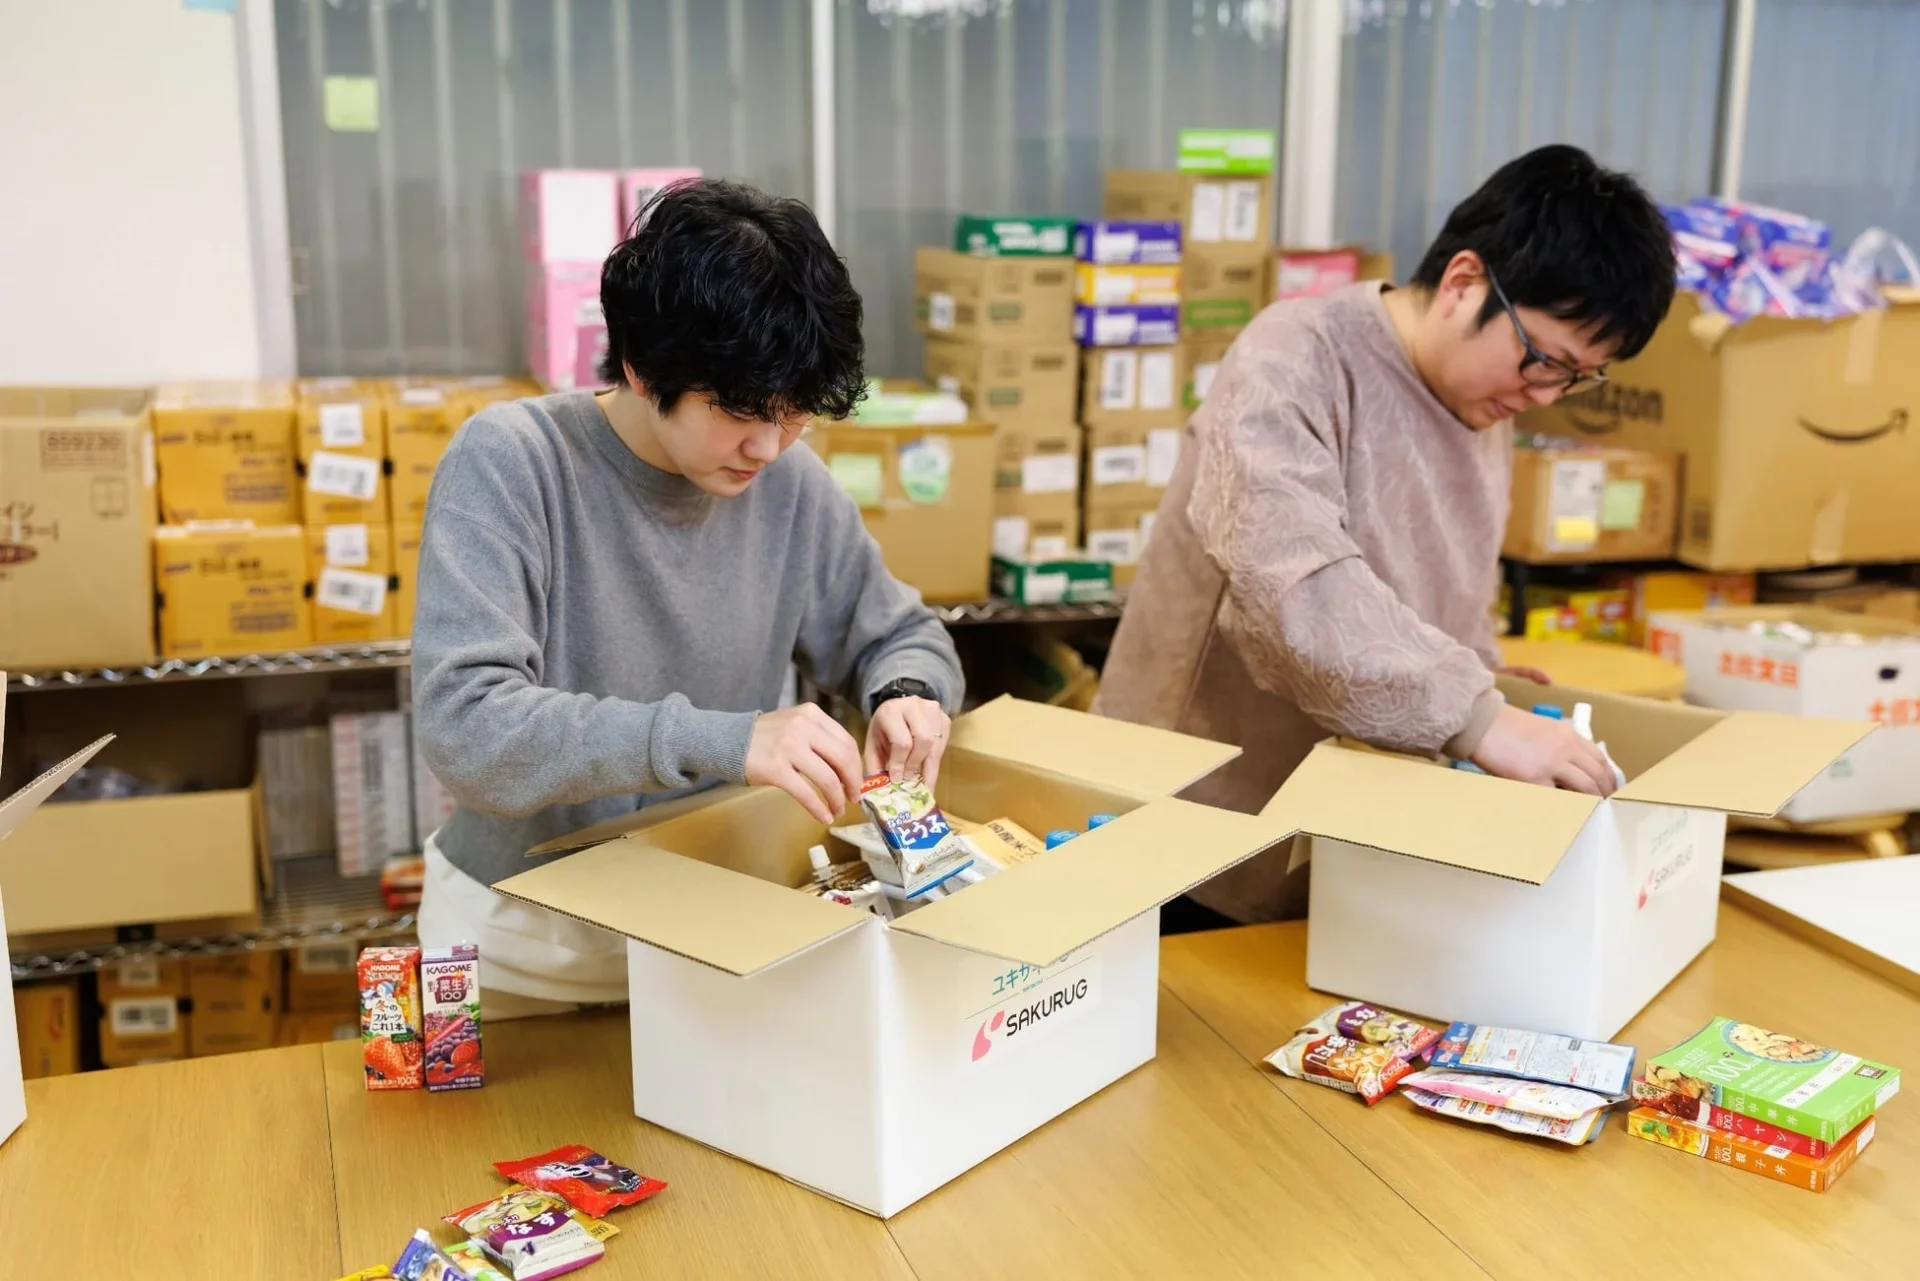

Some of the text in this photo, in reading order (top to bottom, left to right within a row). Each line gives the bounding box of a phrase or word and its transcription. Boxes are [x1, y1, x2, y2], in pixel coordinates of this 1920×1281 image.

[370, 964, 401, 972] KAGOME
[426, 963, 473, 975] KAGOME
[427, 977, 474, 994] 野菜生活
[440, 990, 463, 1002] 100
[375, 999, 398, 1012] 冬の
[1006, 978, 1088, 1037] SAKURUG
[373, 1013, 402, 1023] フルーツ
[1736, 1117, 1788, 1143] ハヤシ
[1735, 1151, 1788, 1177] 親子丼
[506, 1211, 556, 1235] なす
